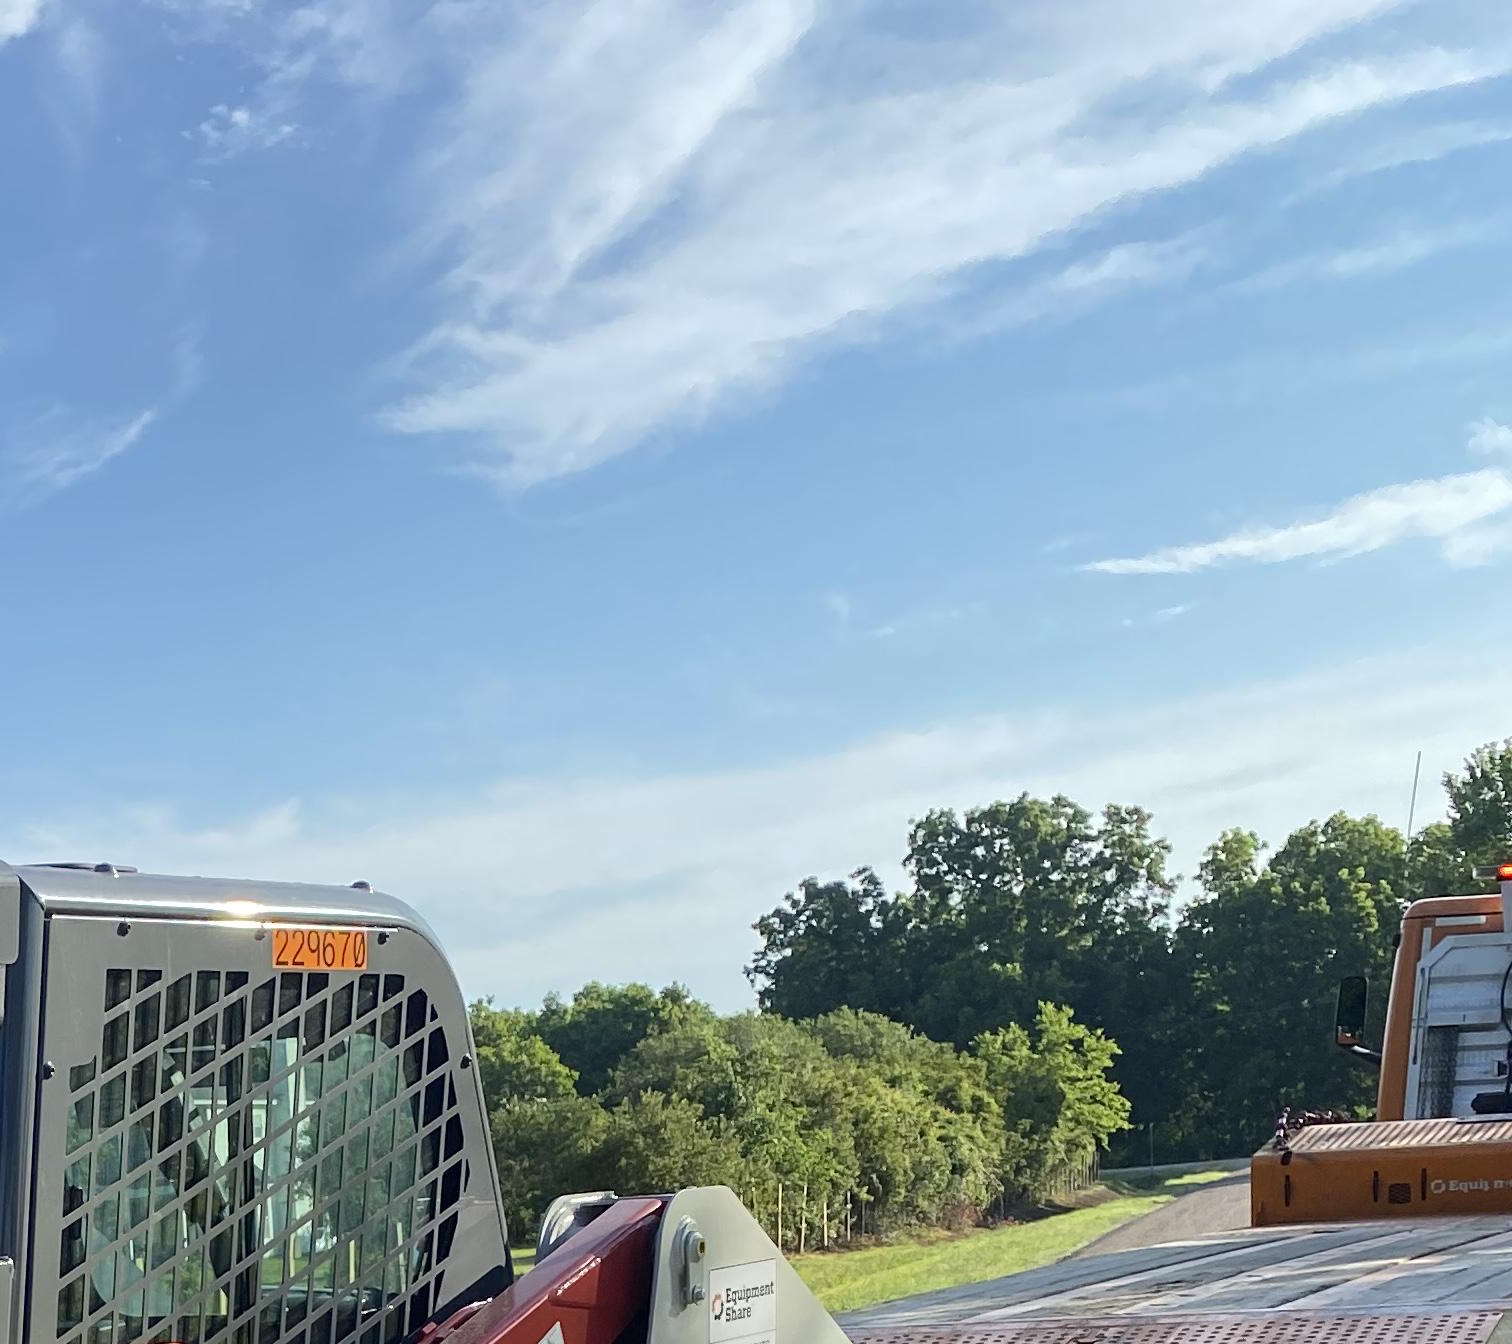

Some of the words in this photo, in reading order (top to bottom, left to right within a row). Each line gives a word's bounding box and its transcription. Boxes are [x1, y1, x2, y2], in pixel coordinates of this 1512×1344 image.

[275, 929, 366, 968] 229670
[725, 1281, 775, 1306] Equipment
[725, 1306, 752, 1323] Share
